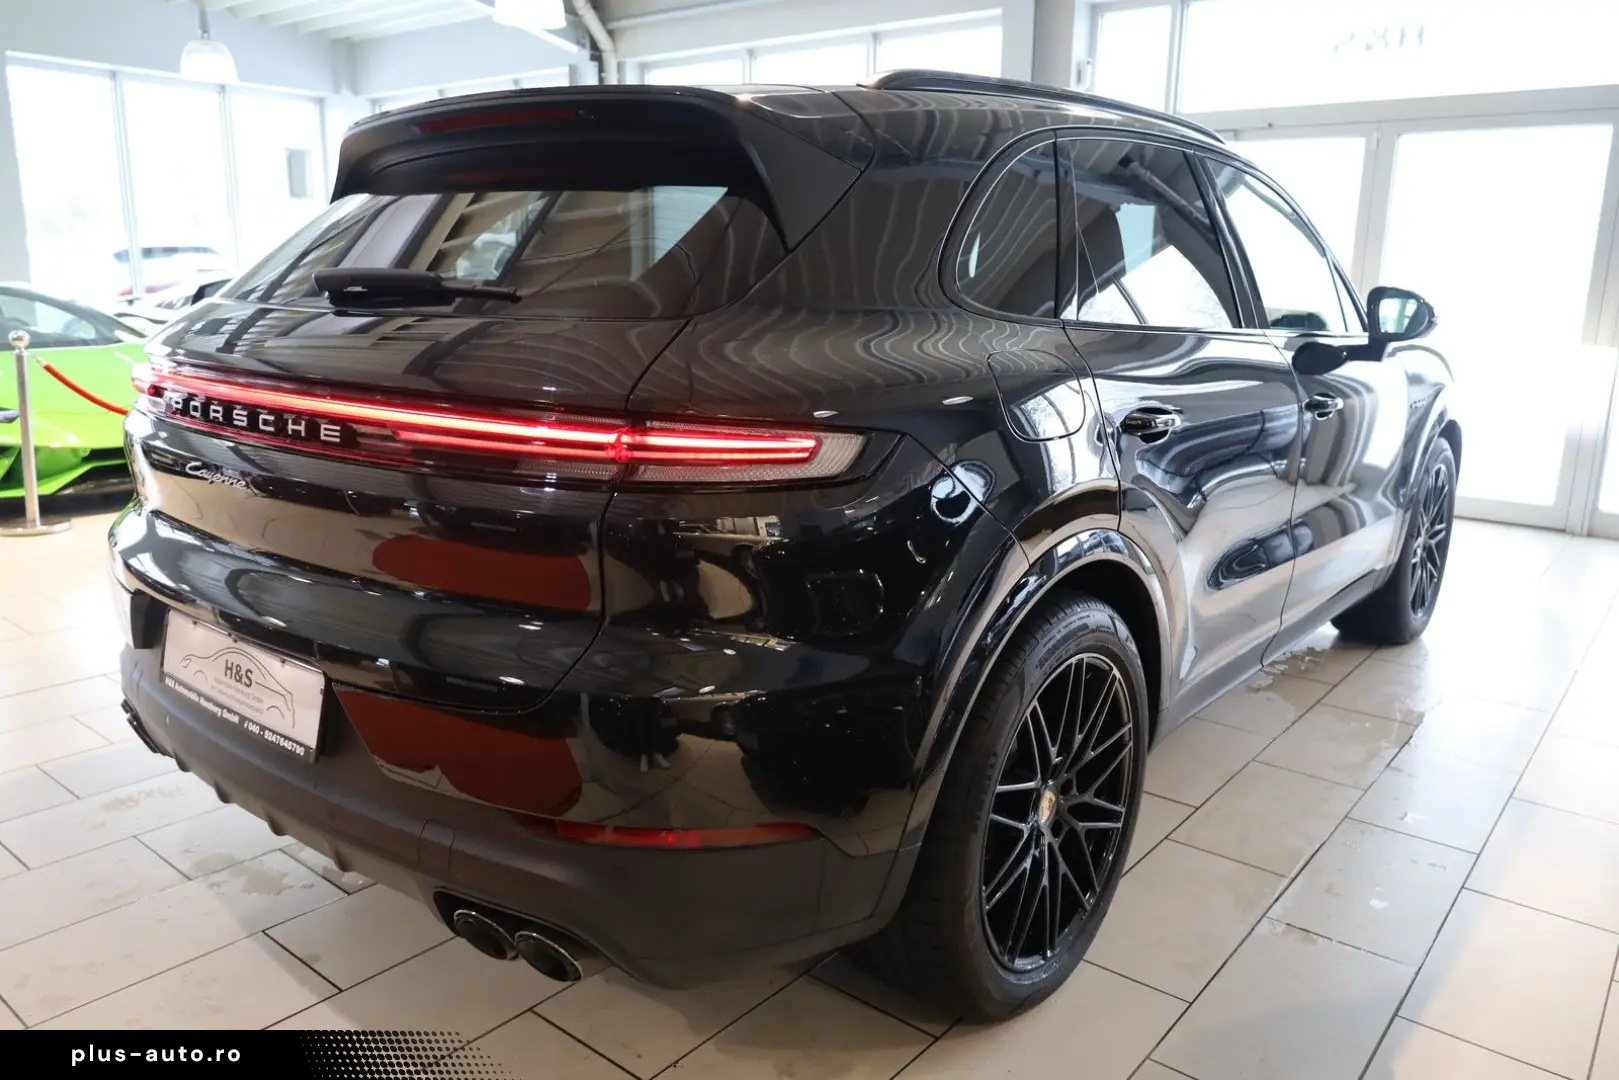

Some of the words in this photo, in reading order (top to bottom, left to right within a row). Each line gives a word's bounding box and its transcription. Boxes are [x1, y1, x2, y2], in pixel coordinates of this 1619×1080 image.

[171, 398, 341, 443] PORSCHE
[185, 461, 248, 490] Cayenne
[224, 658, 254, 688] H&S
